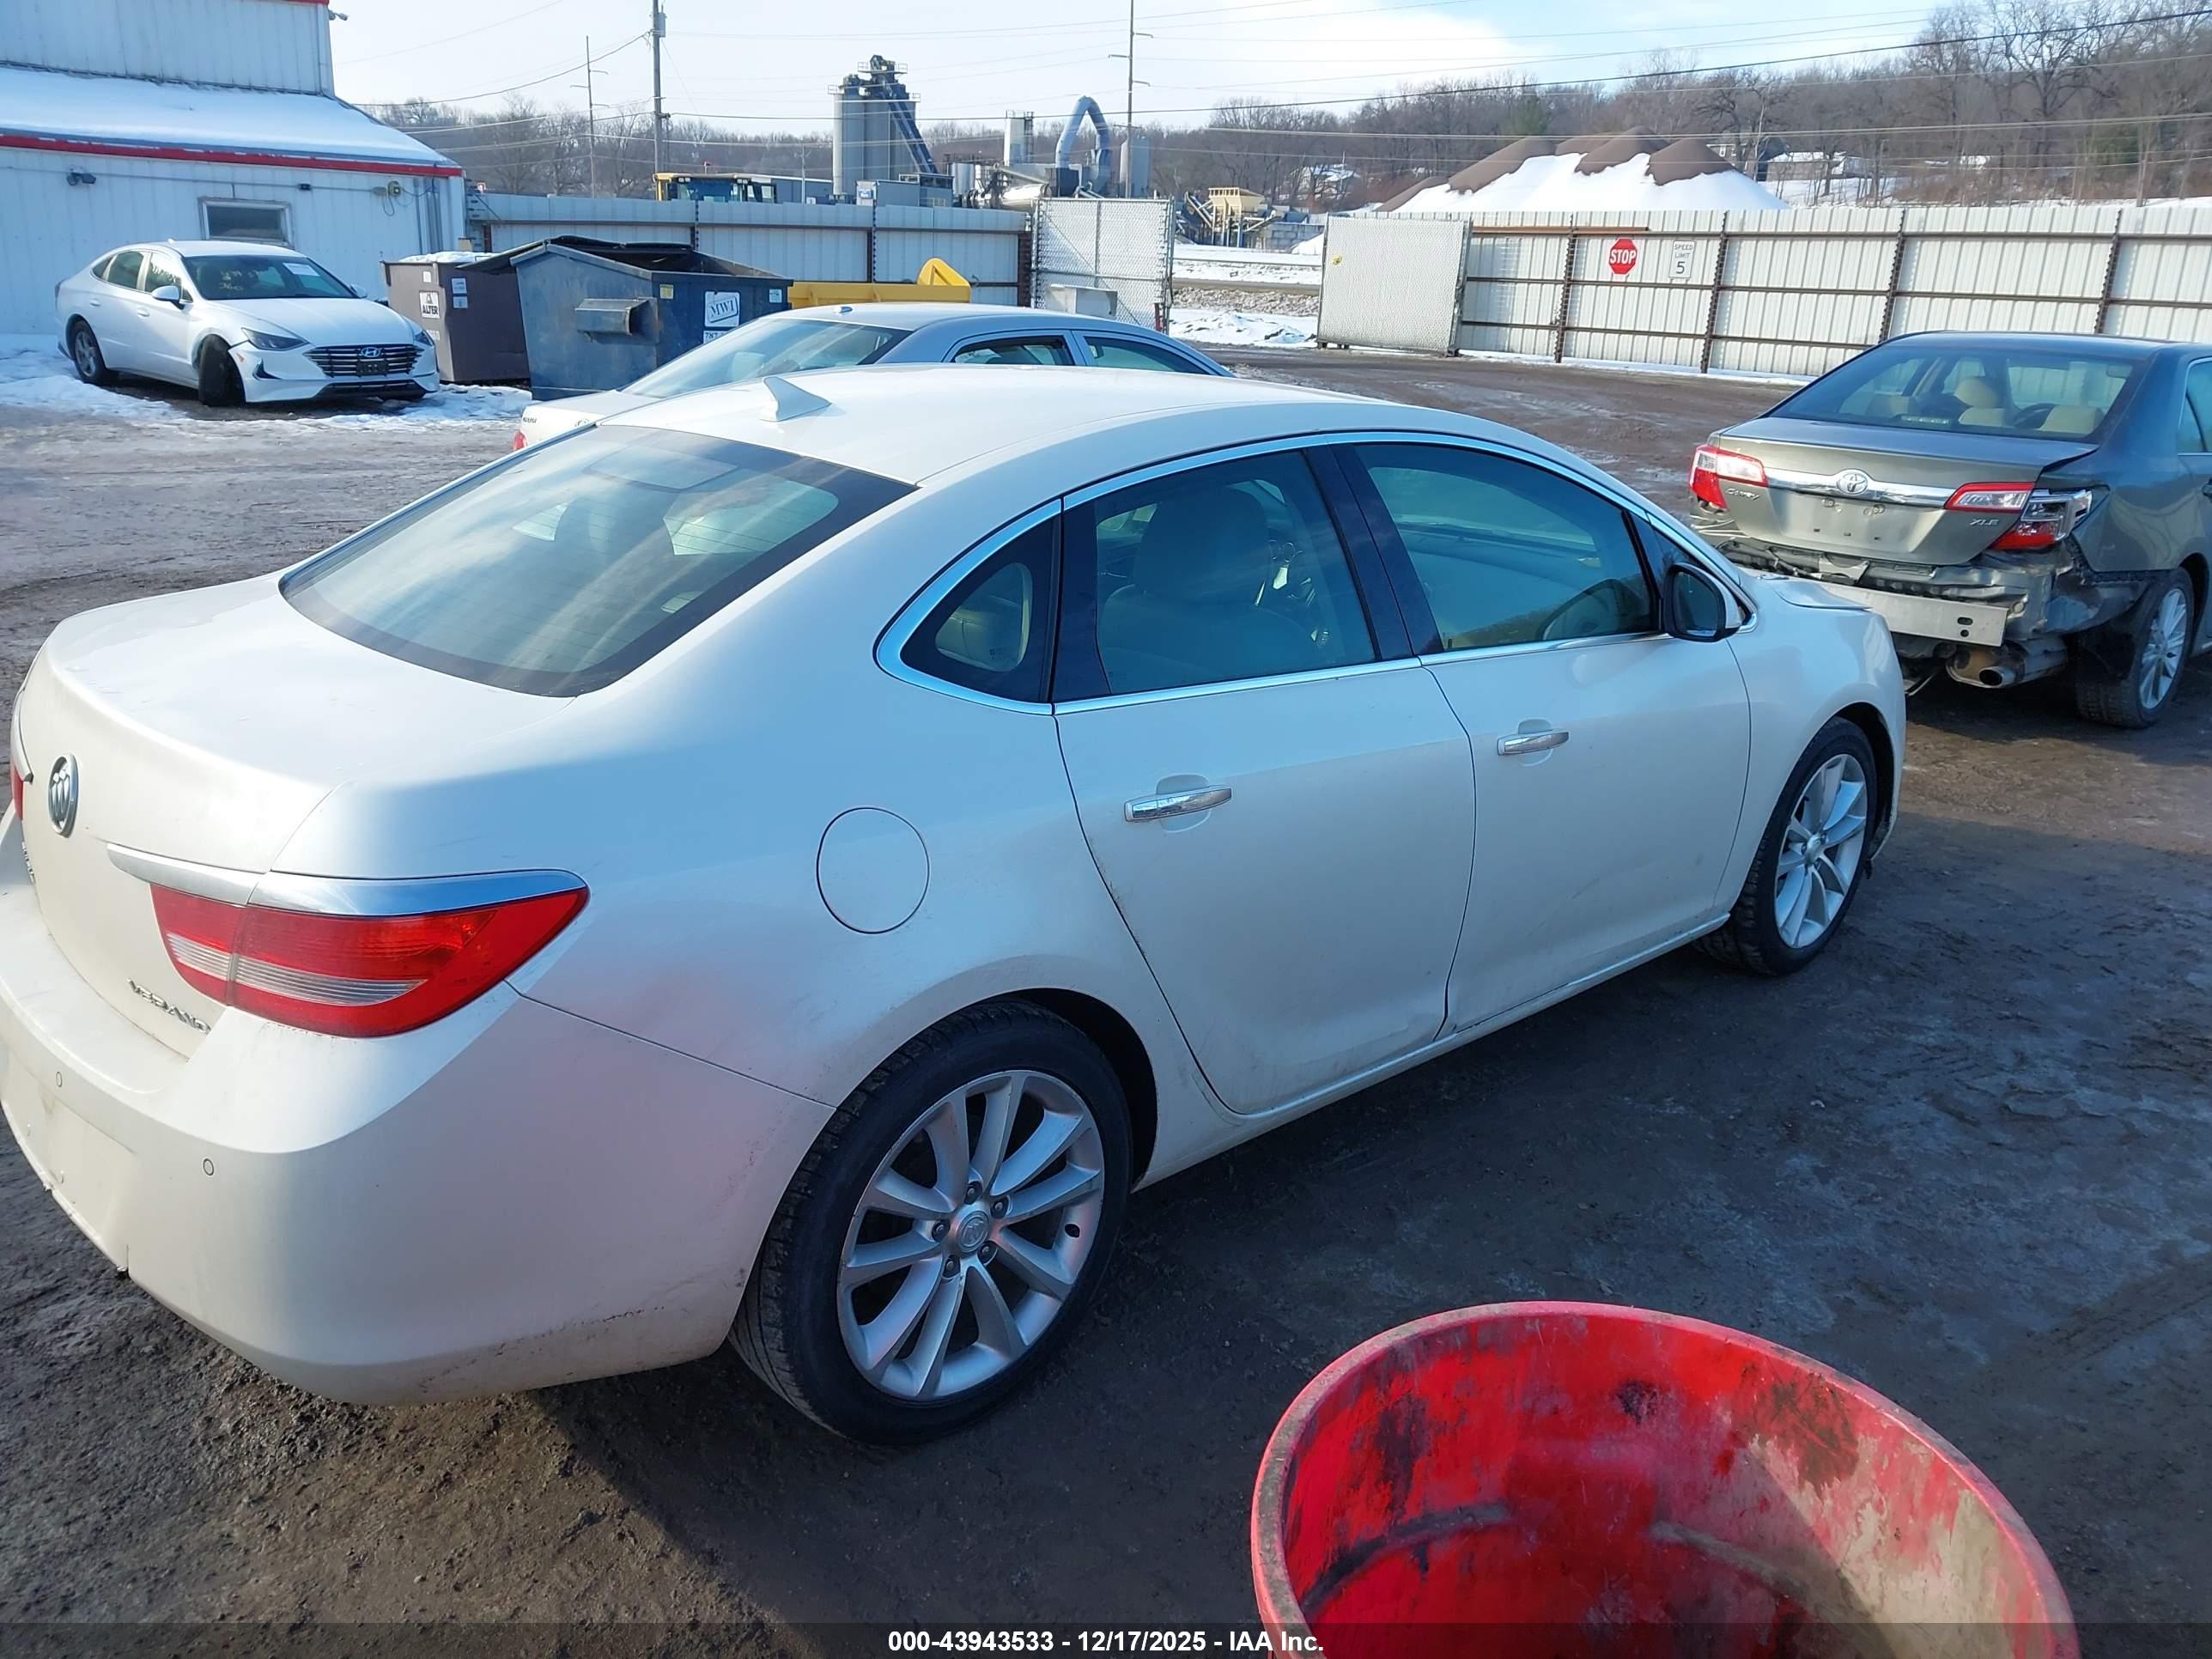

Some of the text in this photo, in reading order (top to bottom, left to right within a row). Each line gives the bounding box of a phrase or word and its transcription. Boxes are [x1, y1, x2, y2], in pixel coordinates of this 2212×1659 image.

[1610, 249, 1637, 264] STOP
[1675, 261, 1686, 274] 5
[422, 304, 439, 315] ALTER
[710, 300, 735, 317] MWI
[1970, 518, 2000, 526] XLE
[126, 977, 212, 1035] VERANO
